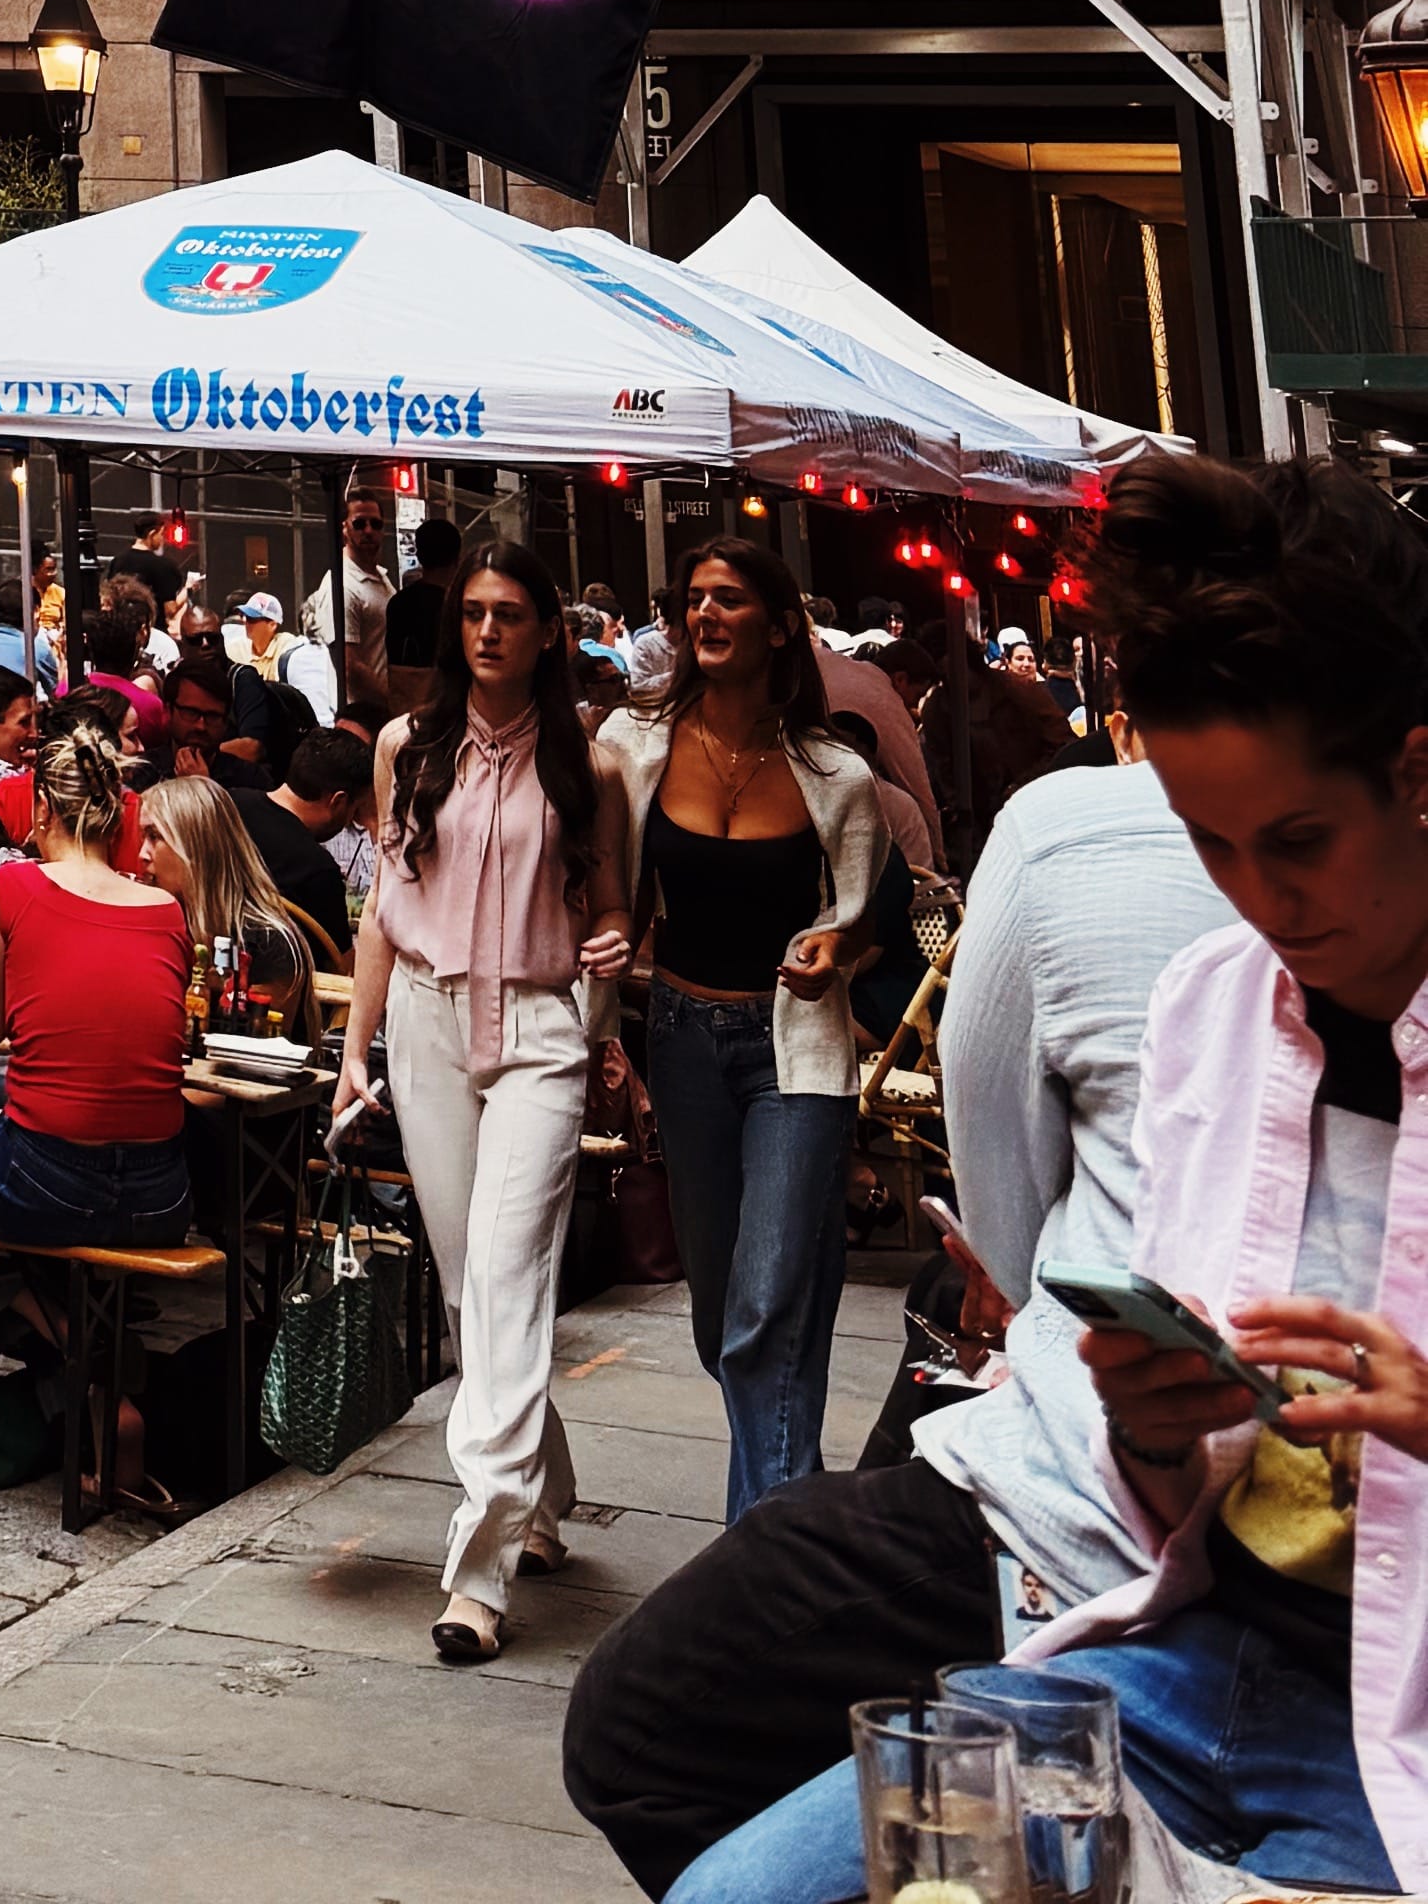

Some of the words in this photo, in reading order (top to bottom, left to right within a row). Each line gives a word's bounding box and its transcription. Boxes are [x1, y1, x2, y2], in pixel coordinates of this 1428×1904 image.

[175, 239, 344, 260] Oktoberfest
[152, 366, 484, 448] Oktoberfest
[613, 388, 665, 413] ABC
